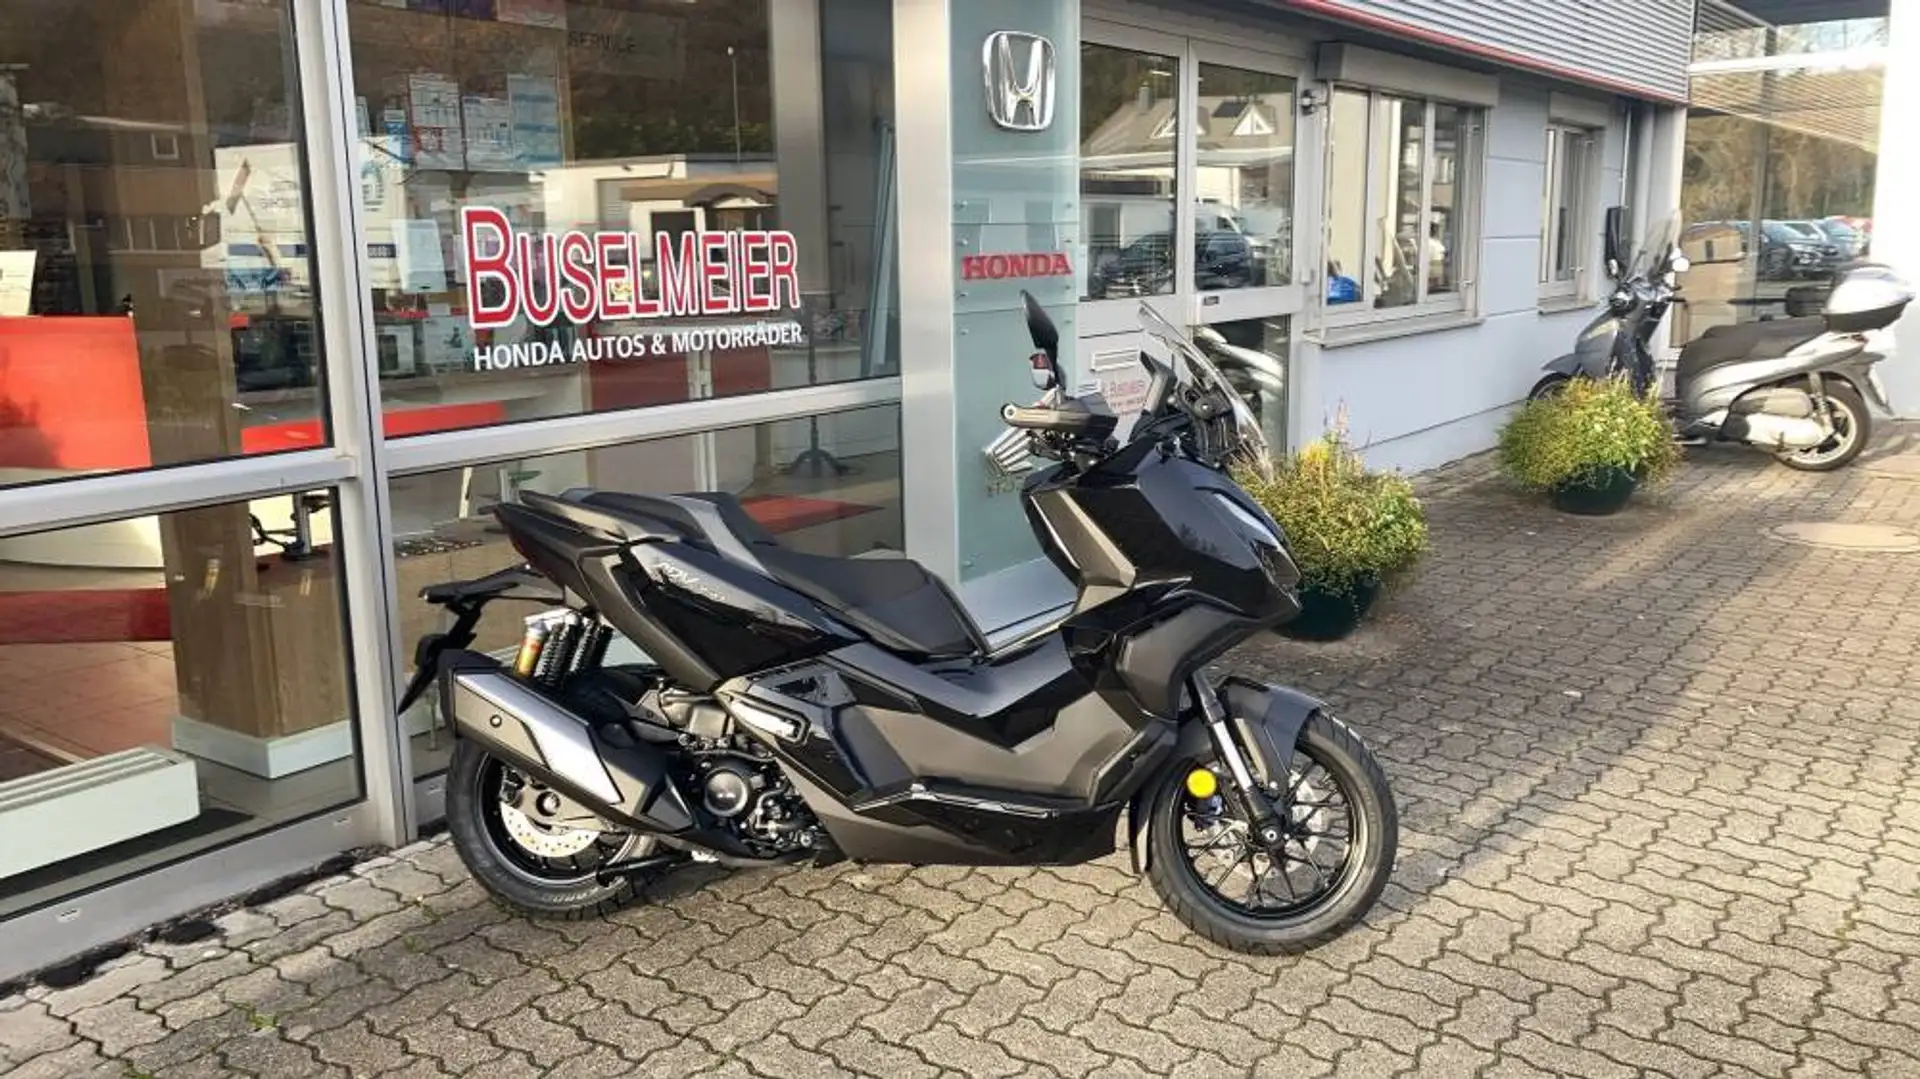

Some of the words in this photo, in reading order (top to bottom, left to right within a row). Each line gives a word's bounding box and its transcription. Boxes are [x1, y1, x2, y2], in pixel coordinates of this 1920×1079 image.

[461, 205, 800, 328] BUSELMEIER
[962, 252, 1072, 280] HONDA
[473, 339, 566, 371] HONDA
[572, 333, 646, 363] AUTOS
[650, 332, 667, 356] &
[672, 320, 803, 354] MOTORRÄDER
